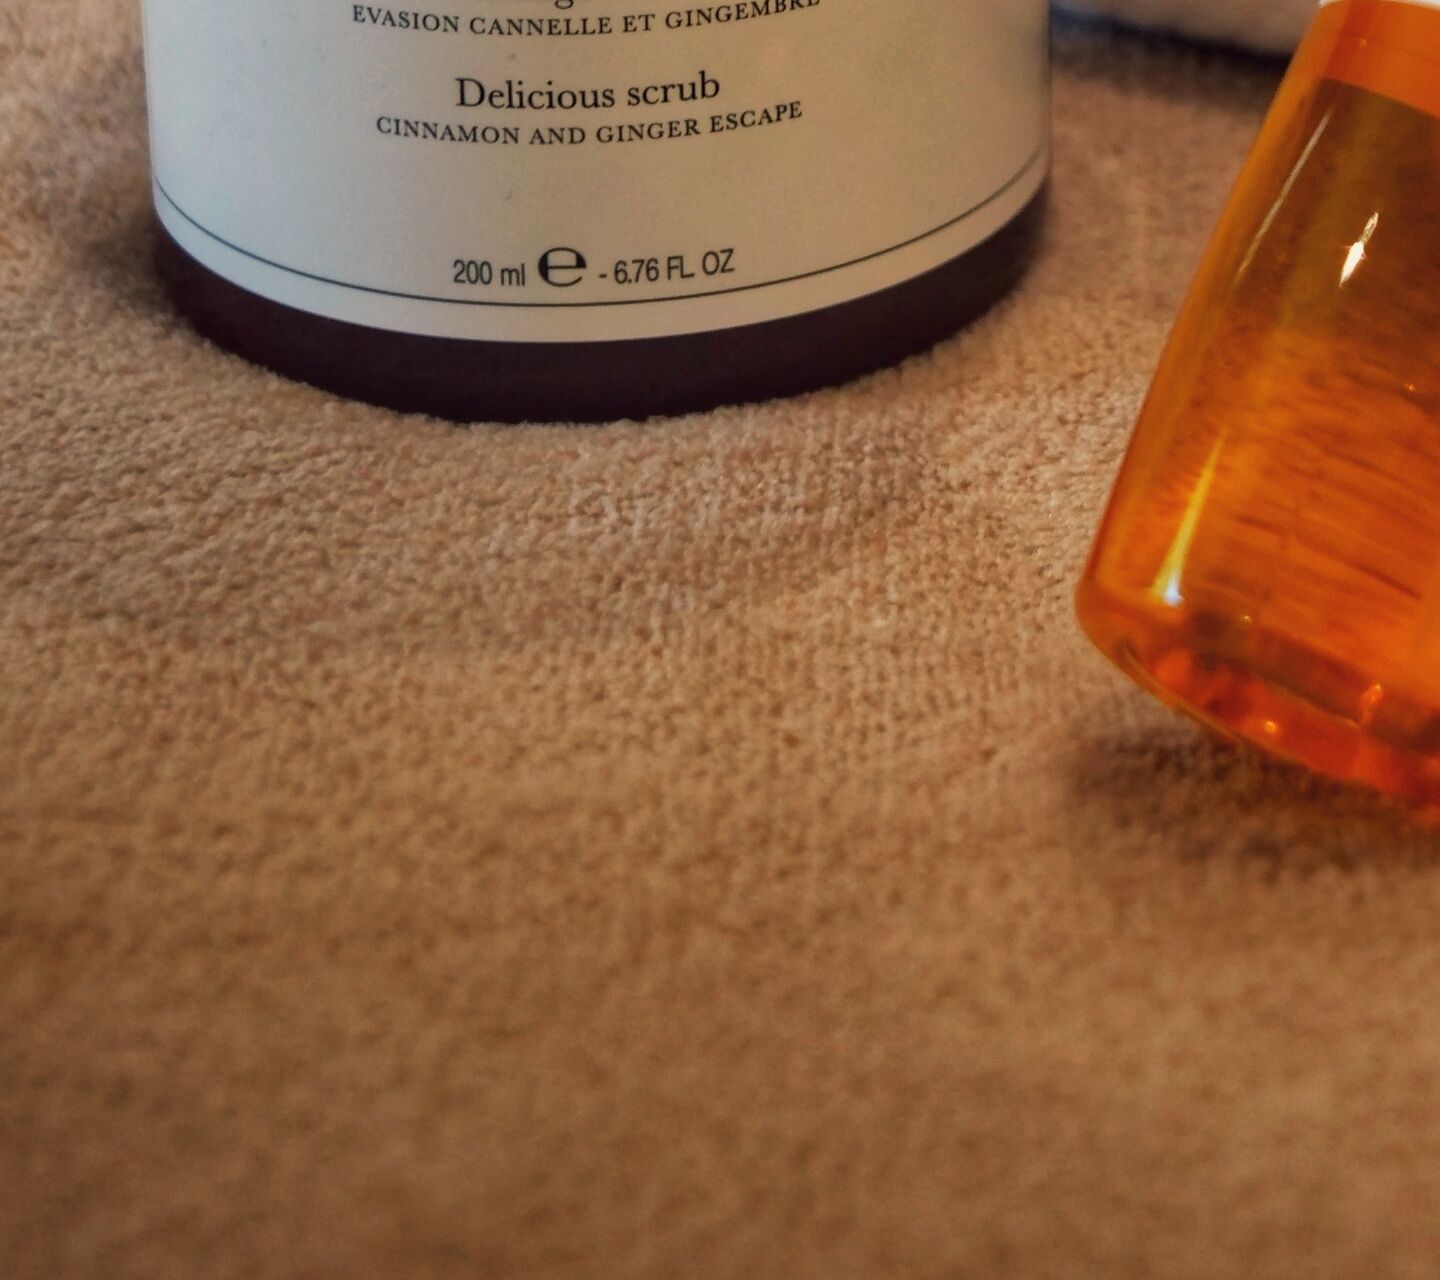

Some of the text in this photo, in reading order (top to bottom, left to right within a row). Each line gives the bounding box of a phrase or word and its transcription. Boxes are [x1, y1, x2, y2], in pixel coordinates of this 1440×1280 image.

[352, 4, 460, 33] EVASION
[469, 16, 612, 36] CANNELLE
[622, 14, 655, 32] ET
[455, 71, 720, 110] Delicious scrub
[376, 101, 802, 145] CINNAMON AND GINGER ESCAPE
[452, 259, 493, 285] 200
[501, 262, 525, 286] ml
[613, 258, 660, 285] 6.76
[667, 254, 695, 280] FL
[702, 248, 735, 275] OZ
